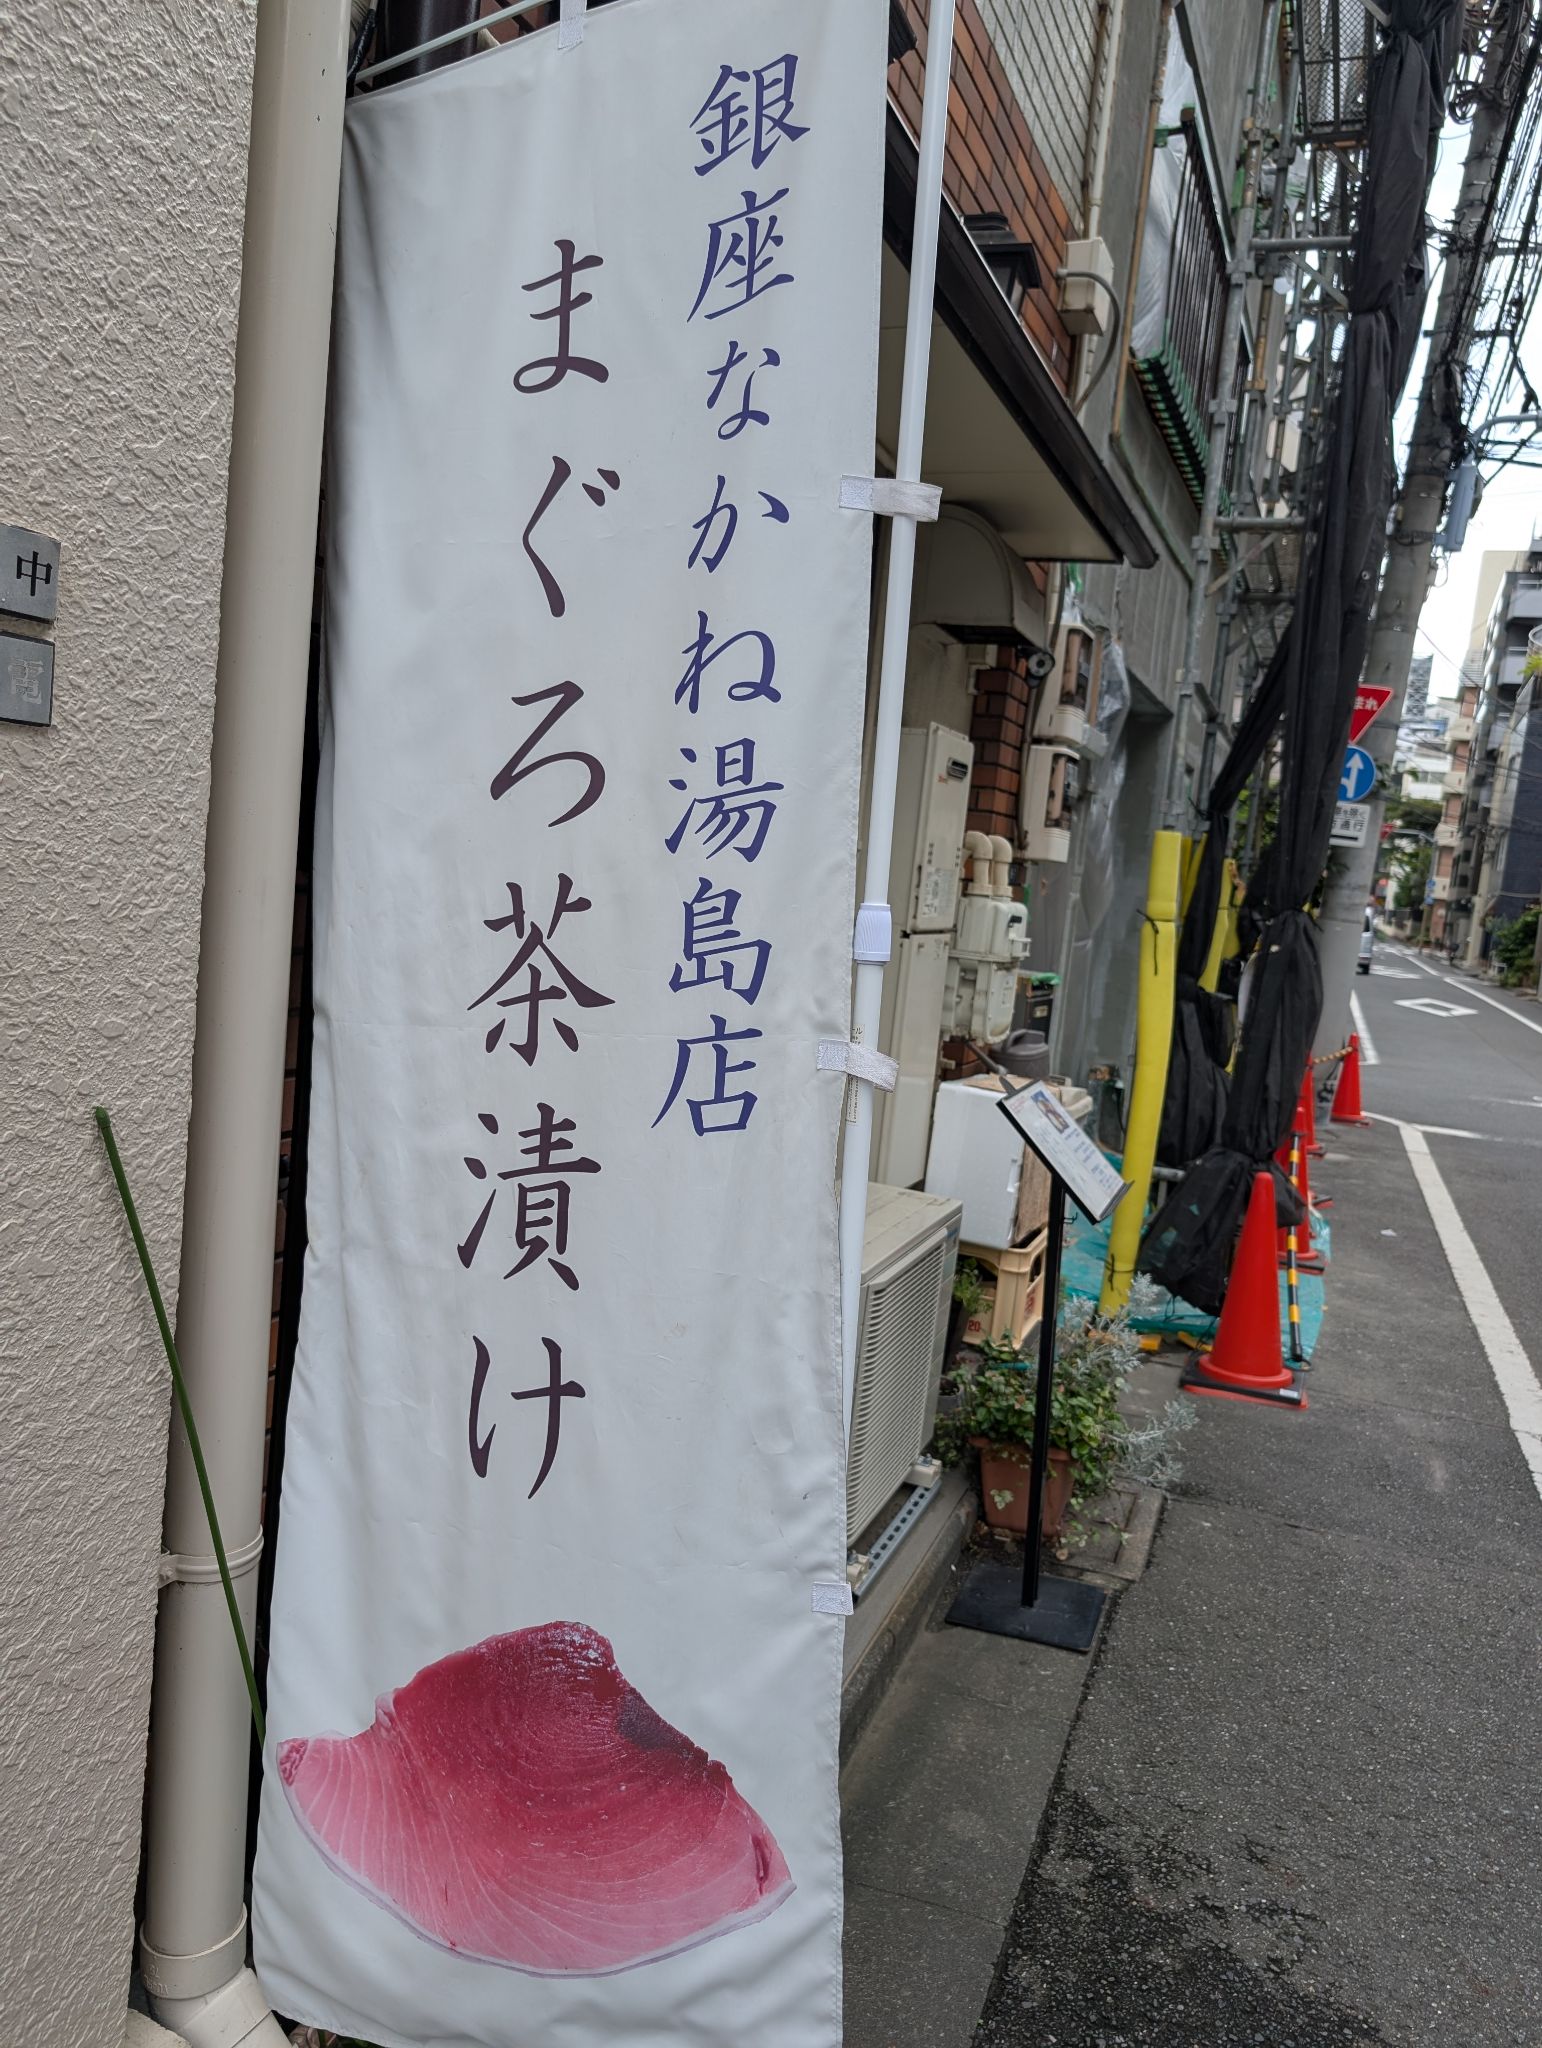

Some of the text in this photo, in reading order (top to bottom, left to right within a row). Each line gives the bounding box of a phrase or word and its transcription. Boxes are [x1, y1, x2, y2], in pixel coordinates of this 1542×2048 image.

[16, 550, 53, 597] 中
[650, 53, 811, 1137] 銀座なかね湯島店
[1353, 695, 1379, 711] まれ
[456, 239, 621, 1500] まぐろ茶漬け
